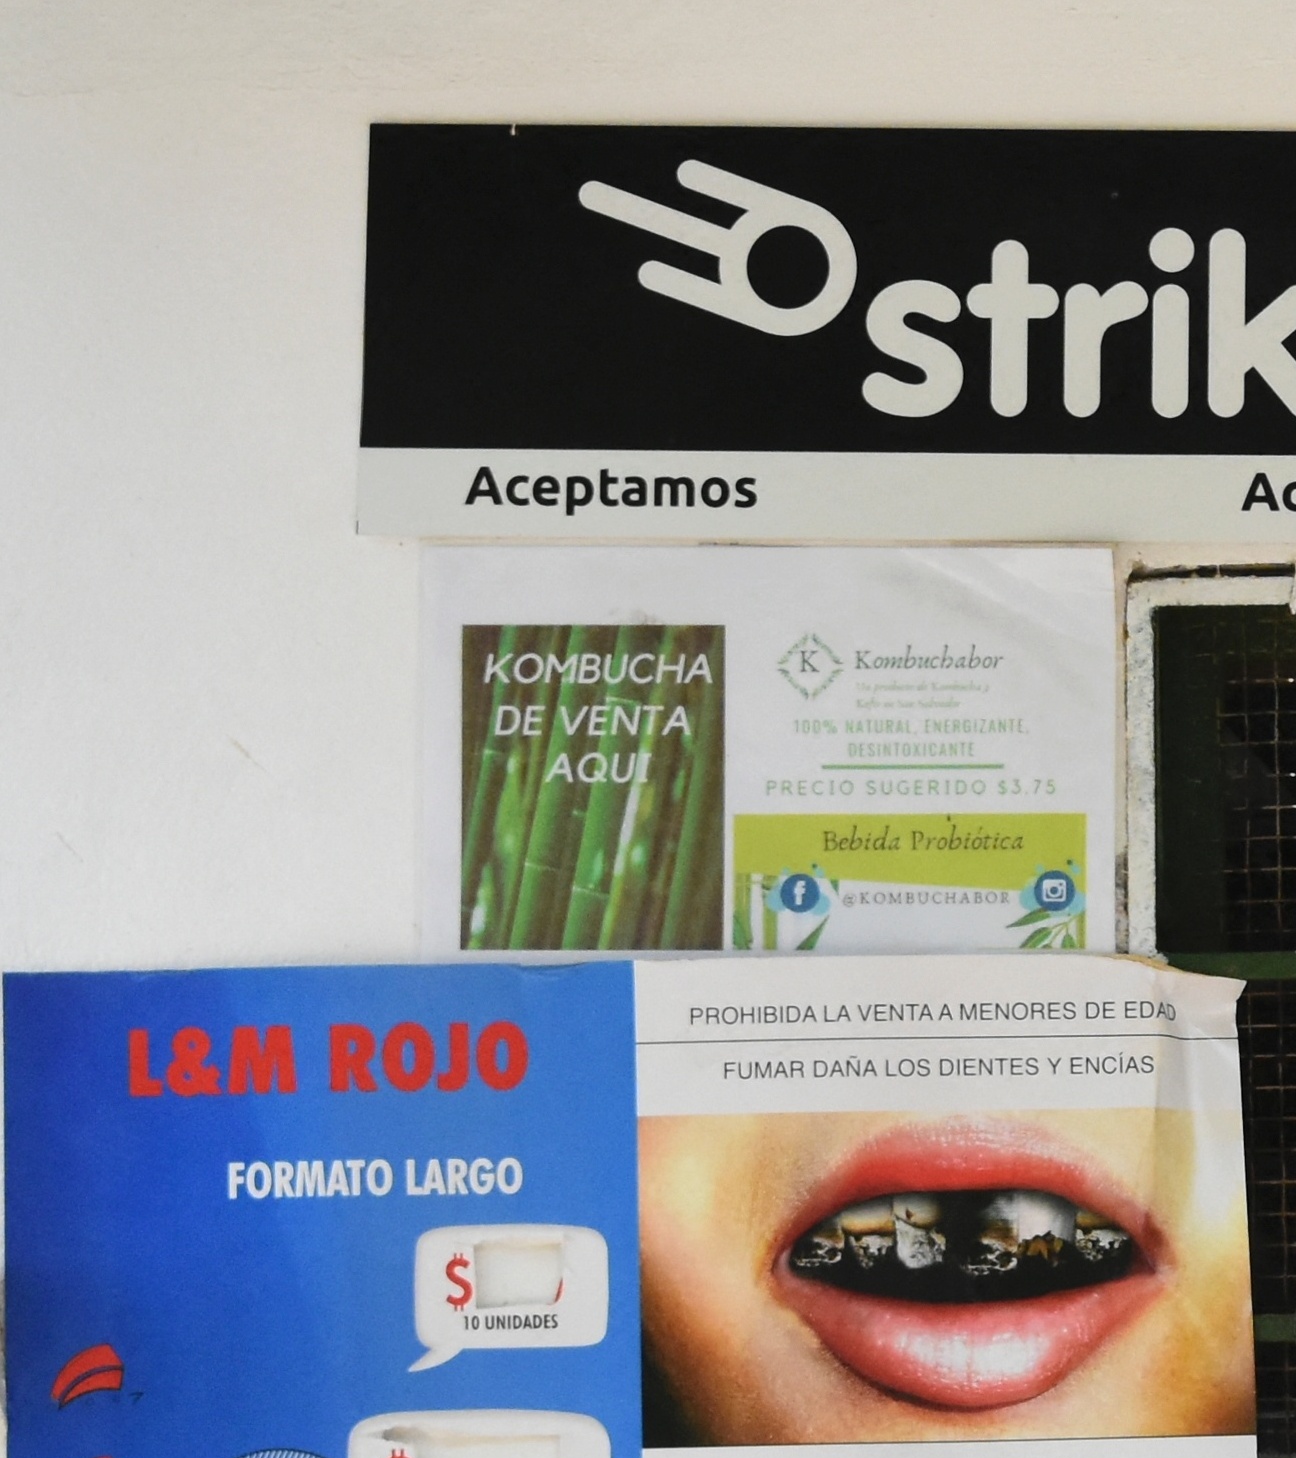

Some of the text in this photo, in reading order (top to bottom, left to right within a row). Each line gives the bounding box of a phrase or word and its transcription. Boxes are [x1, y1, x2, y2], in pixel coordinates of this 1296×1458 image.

[464, 466, 759, 516] Aceptamos
[483, 652, 713, 684] KOMBUCHA
[799, 650, 820, 673] K
[855, 644, 1005, 670] Kombuchabor
[494, 704, 692, 736] DE VENTA
[794, 718, 1030, 735] 100% NATURAL, ENERGIZANTE,
[847, 741, 975, 757] DESINTOXICANTE
[544, 752, 653, 784] AQUI
[765, 778, 1057, 796] PRECIO SUGERIDO $3.75
[823, 824, 1025, 852] Bebida Probiótica
[841, 890, 1011, 907] @KOMBUCHABOR
[689, 1000, 1177, 1026] PROHIBIDA LA VENTA A MENORES DE EDAD
[127, 1020, 530, 1097] L&M ROJO
[723, 1051, 1156, 1081] FUMAR DAÑA LOS DIENTES Y ENCÍAS
[227, 1156, 525, 1200] FORMATO LARGO
[462, 1313, 559, 1331] 10 UNIDADES
